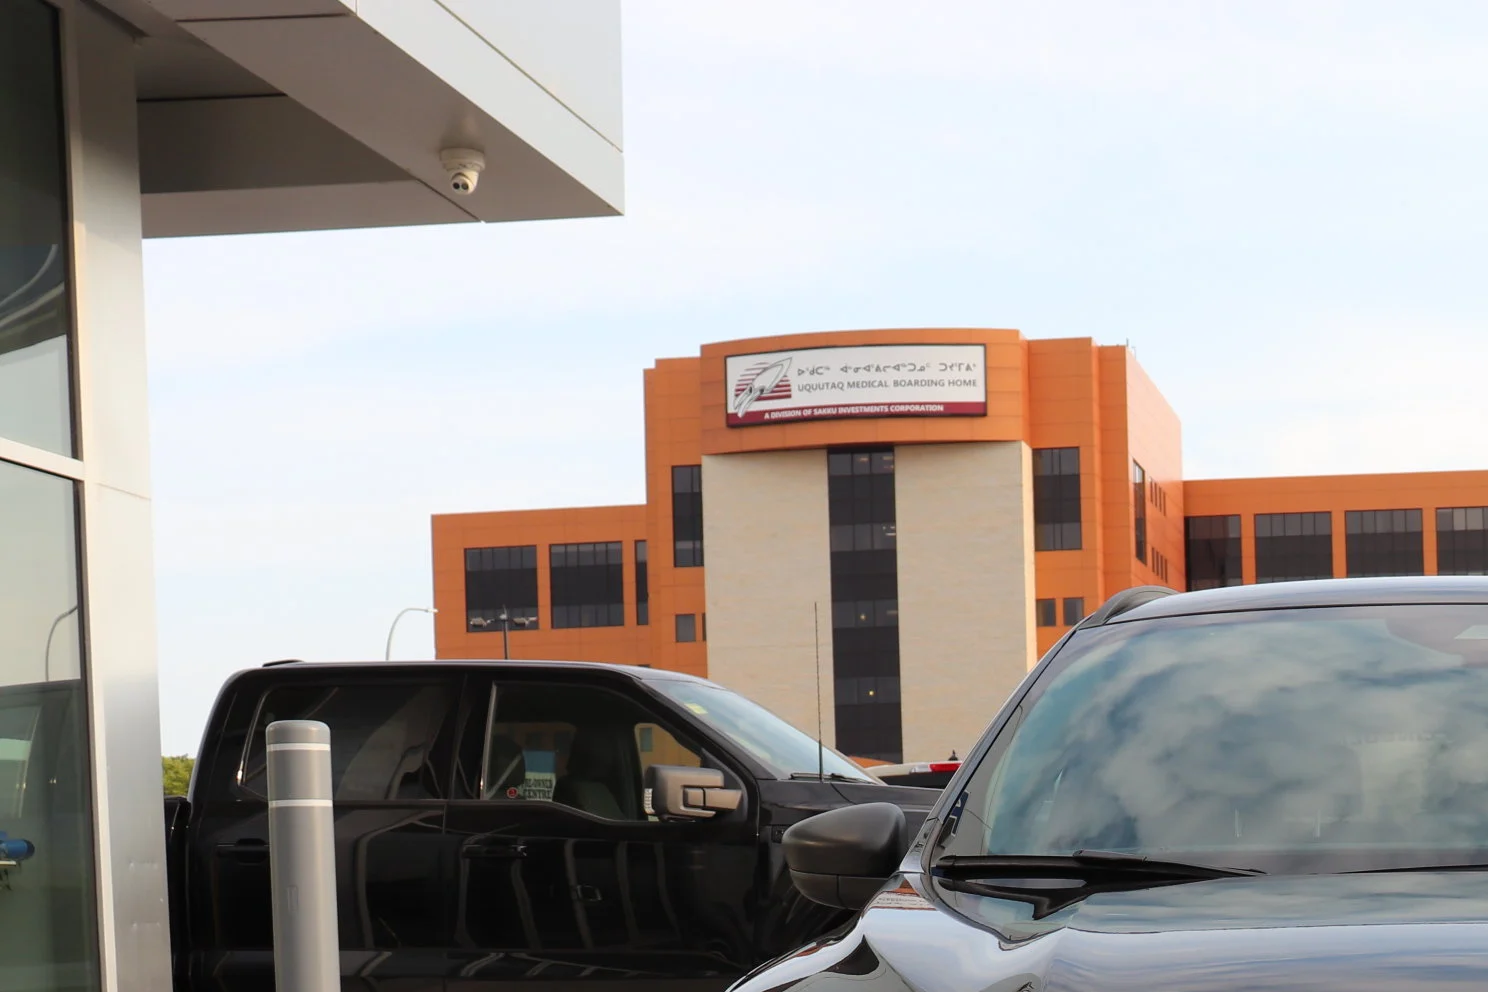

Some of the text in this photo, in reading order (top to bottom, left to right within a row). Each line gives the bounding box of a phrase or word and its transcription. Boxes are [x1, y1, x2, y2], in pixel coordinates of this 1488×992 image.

[797, 379, 977, 393] UQUUTAQ MEDICAL BOARDING HOME
[771, 410, 801, 418] DIVISION
[838, 405, 889, 414] INVESTMENTS
[889, 404, 944, 412] CORPORATION
